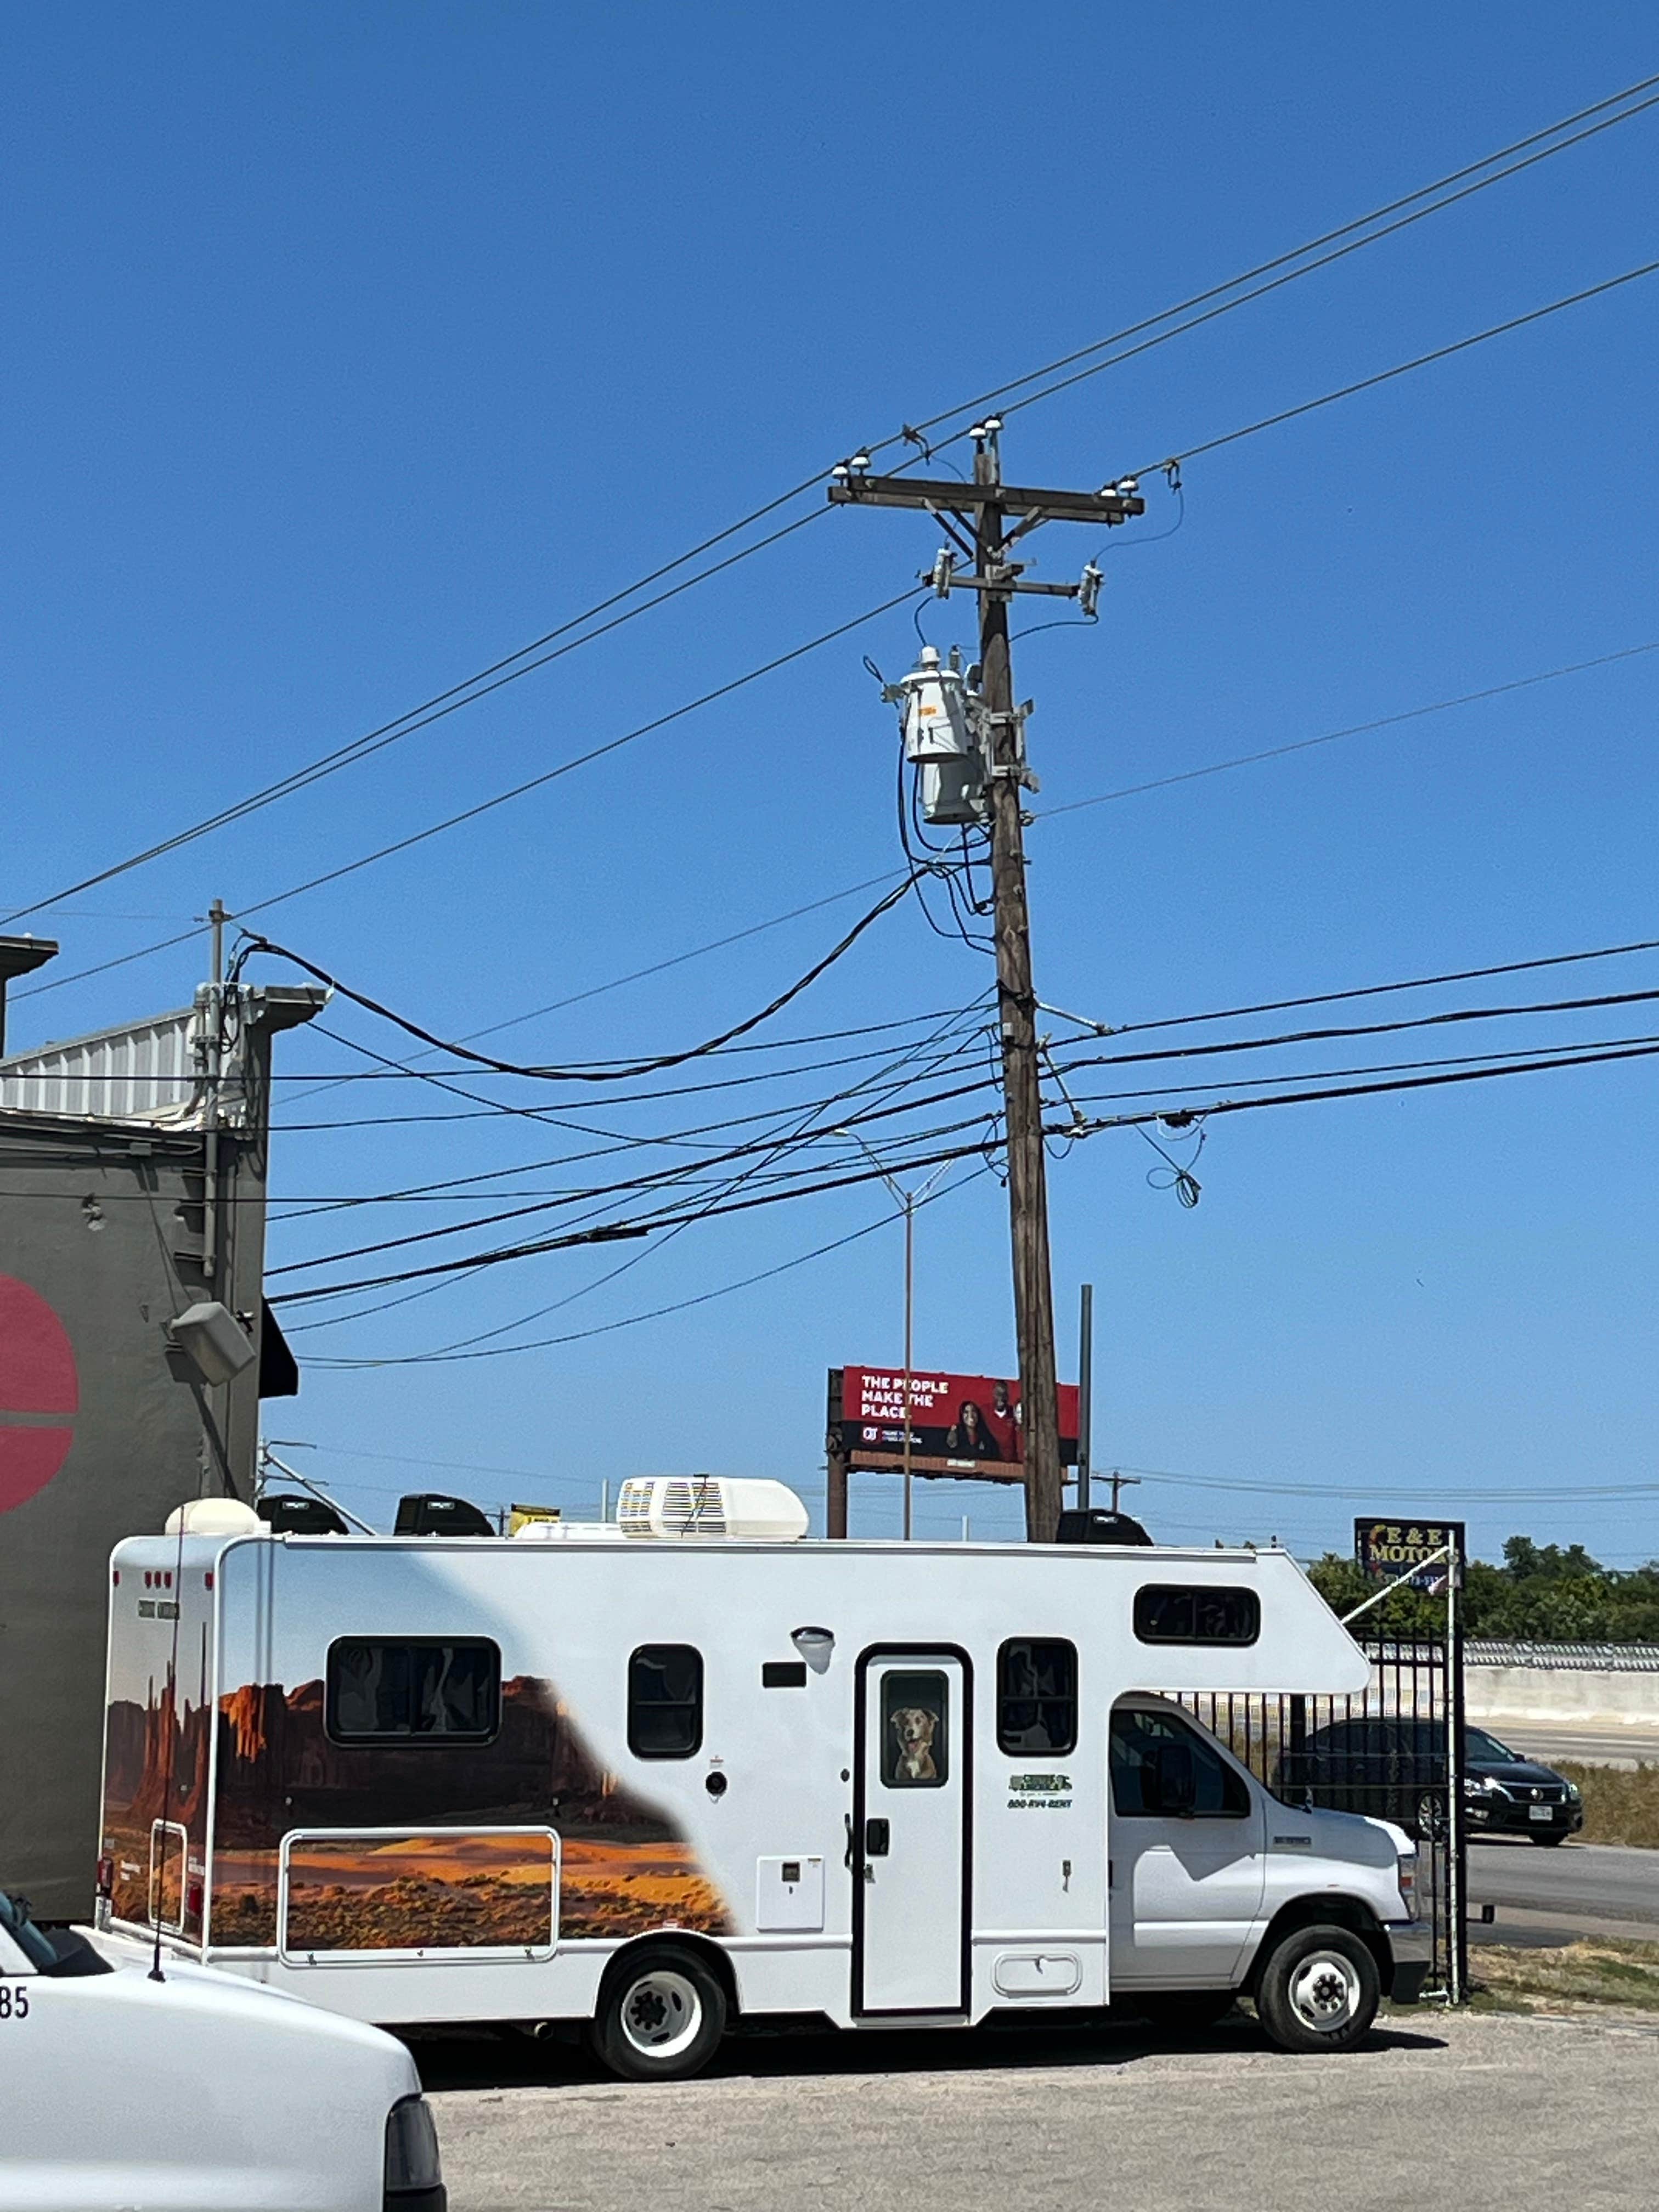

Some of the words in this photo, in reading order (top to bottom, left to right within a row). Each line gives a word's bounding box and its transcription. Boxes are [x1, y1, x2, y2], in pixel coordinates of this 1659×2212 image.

[861, 1374, 890, 1390] THE
[893, 1378, 949, 1394] PEOPLE
[861, 1390, 903, 1404] MAKE
[908, 1393, 934, 1408] THE
[1386, 1526, 1402, 1544] E
[1406, 1527, 1424, 1545] &
[1426, 1528, 1443, 1545] E
[0, 1985, 29, 2019] 85
